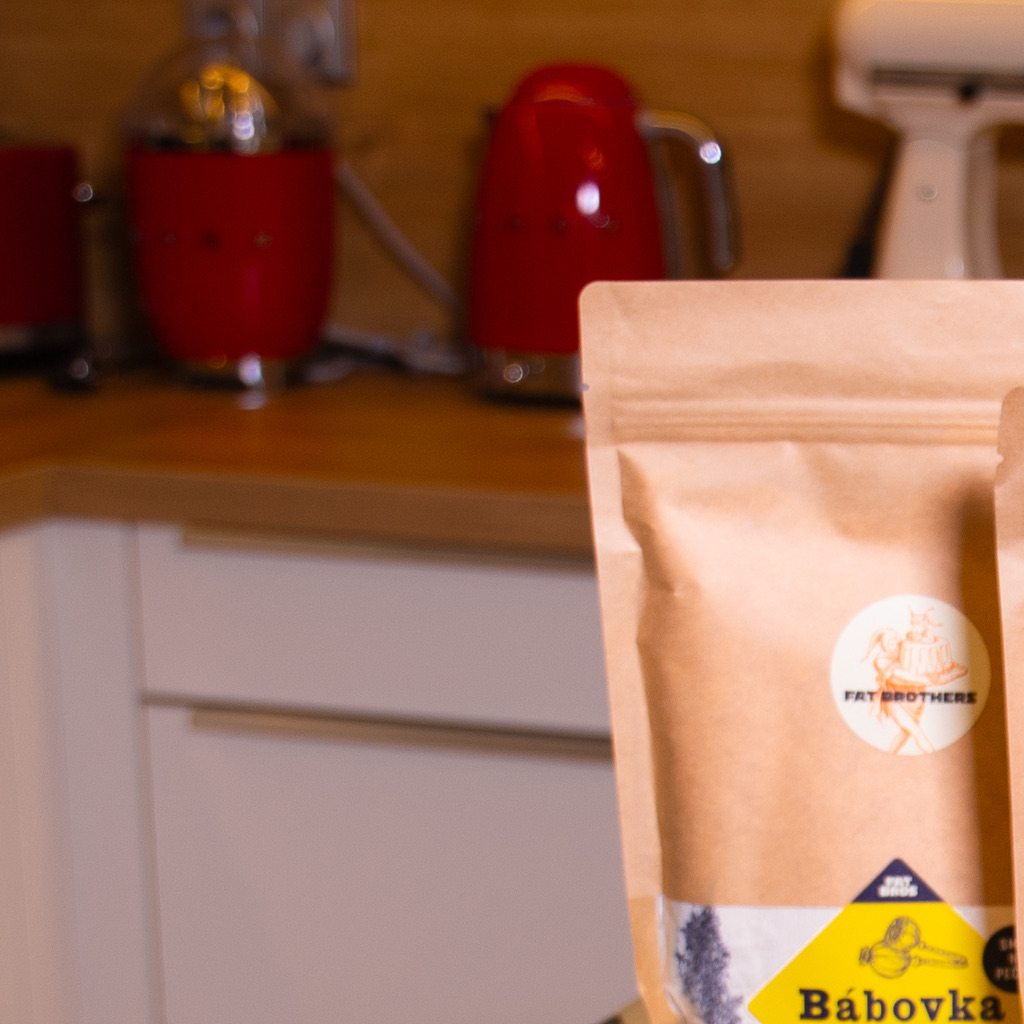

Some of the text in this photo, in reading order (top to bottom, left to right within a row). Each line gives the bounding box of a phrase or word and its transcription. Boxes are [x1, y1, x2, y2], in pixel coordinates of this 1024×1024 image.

[844, 691, 977, 704] FAT BROTHERS
[798, 987, 1005, 1022] Bábovka
